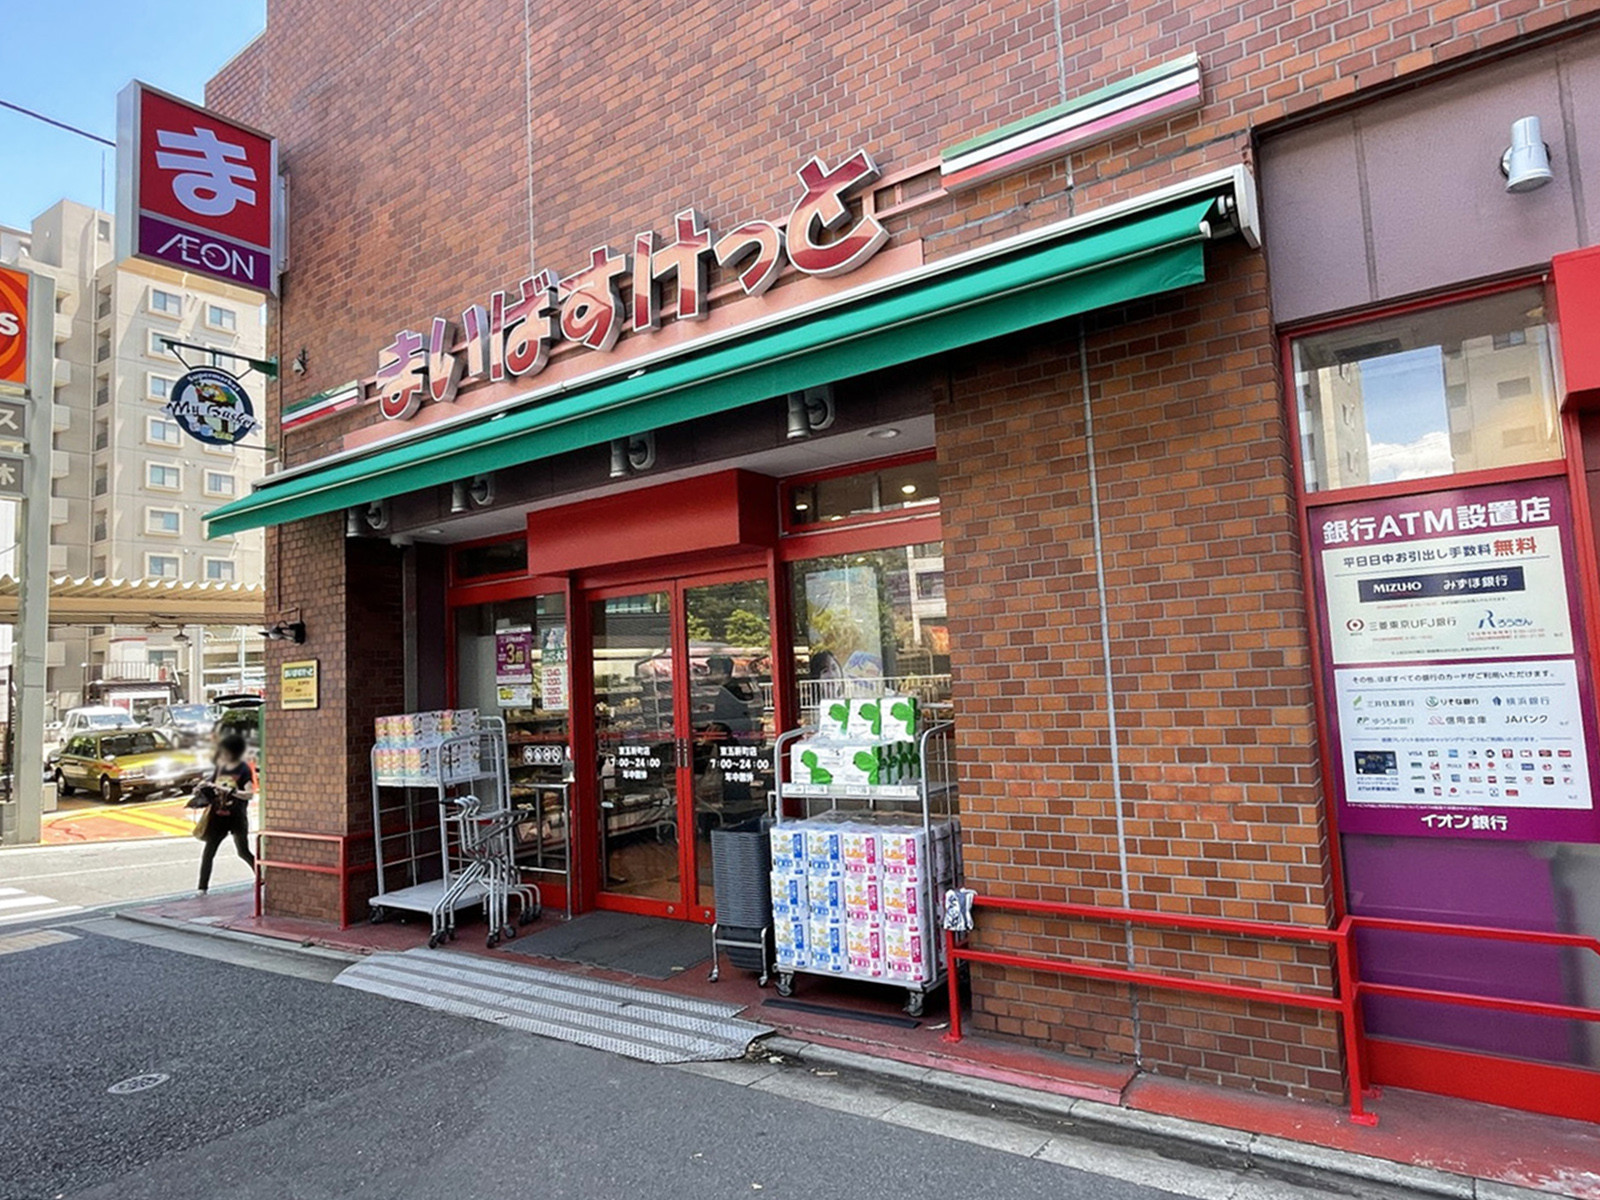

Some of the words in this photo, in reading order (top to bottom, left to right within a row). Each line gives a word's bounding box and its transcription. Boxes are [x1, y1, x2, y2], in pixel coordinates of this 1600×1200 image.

[155, 127, 257, 216] ま
[376, 148, 893, 421] まいばすけっと
[166, 400, 200, 417] My
[1322, 497, 1551, 545] 銀行ATM設置店
[1373, 581, 1423, 594] MIZUHO
[1443, 575, 1509, 591] みずほ銀行
[1369, 616, 1457, 632] 三菱東京UFJ銀行
[1367, 699, 1415, 708] 三井住友銀行
[1440, 697, 1479, 706] りそな銀行
[1506, 696, 1550, 705] 横浜銀行
[1372, 717, 1415, 725] ゆうちょ銀行
[1445, 715, 1487, 725] 信用金庫
[1505, 714, 1549, 724] JAバンク
[1421, 813, 1508, 831] イオン銀行
